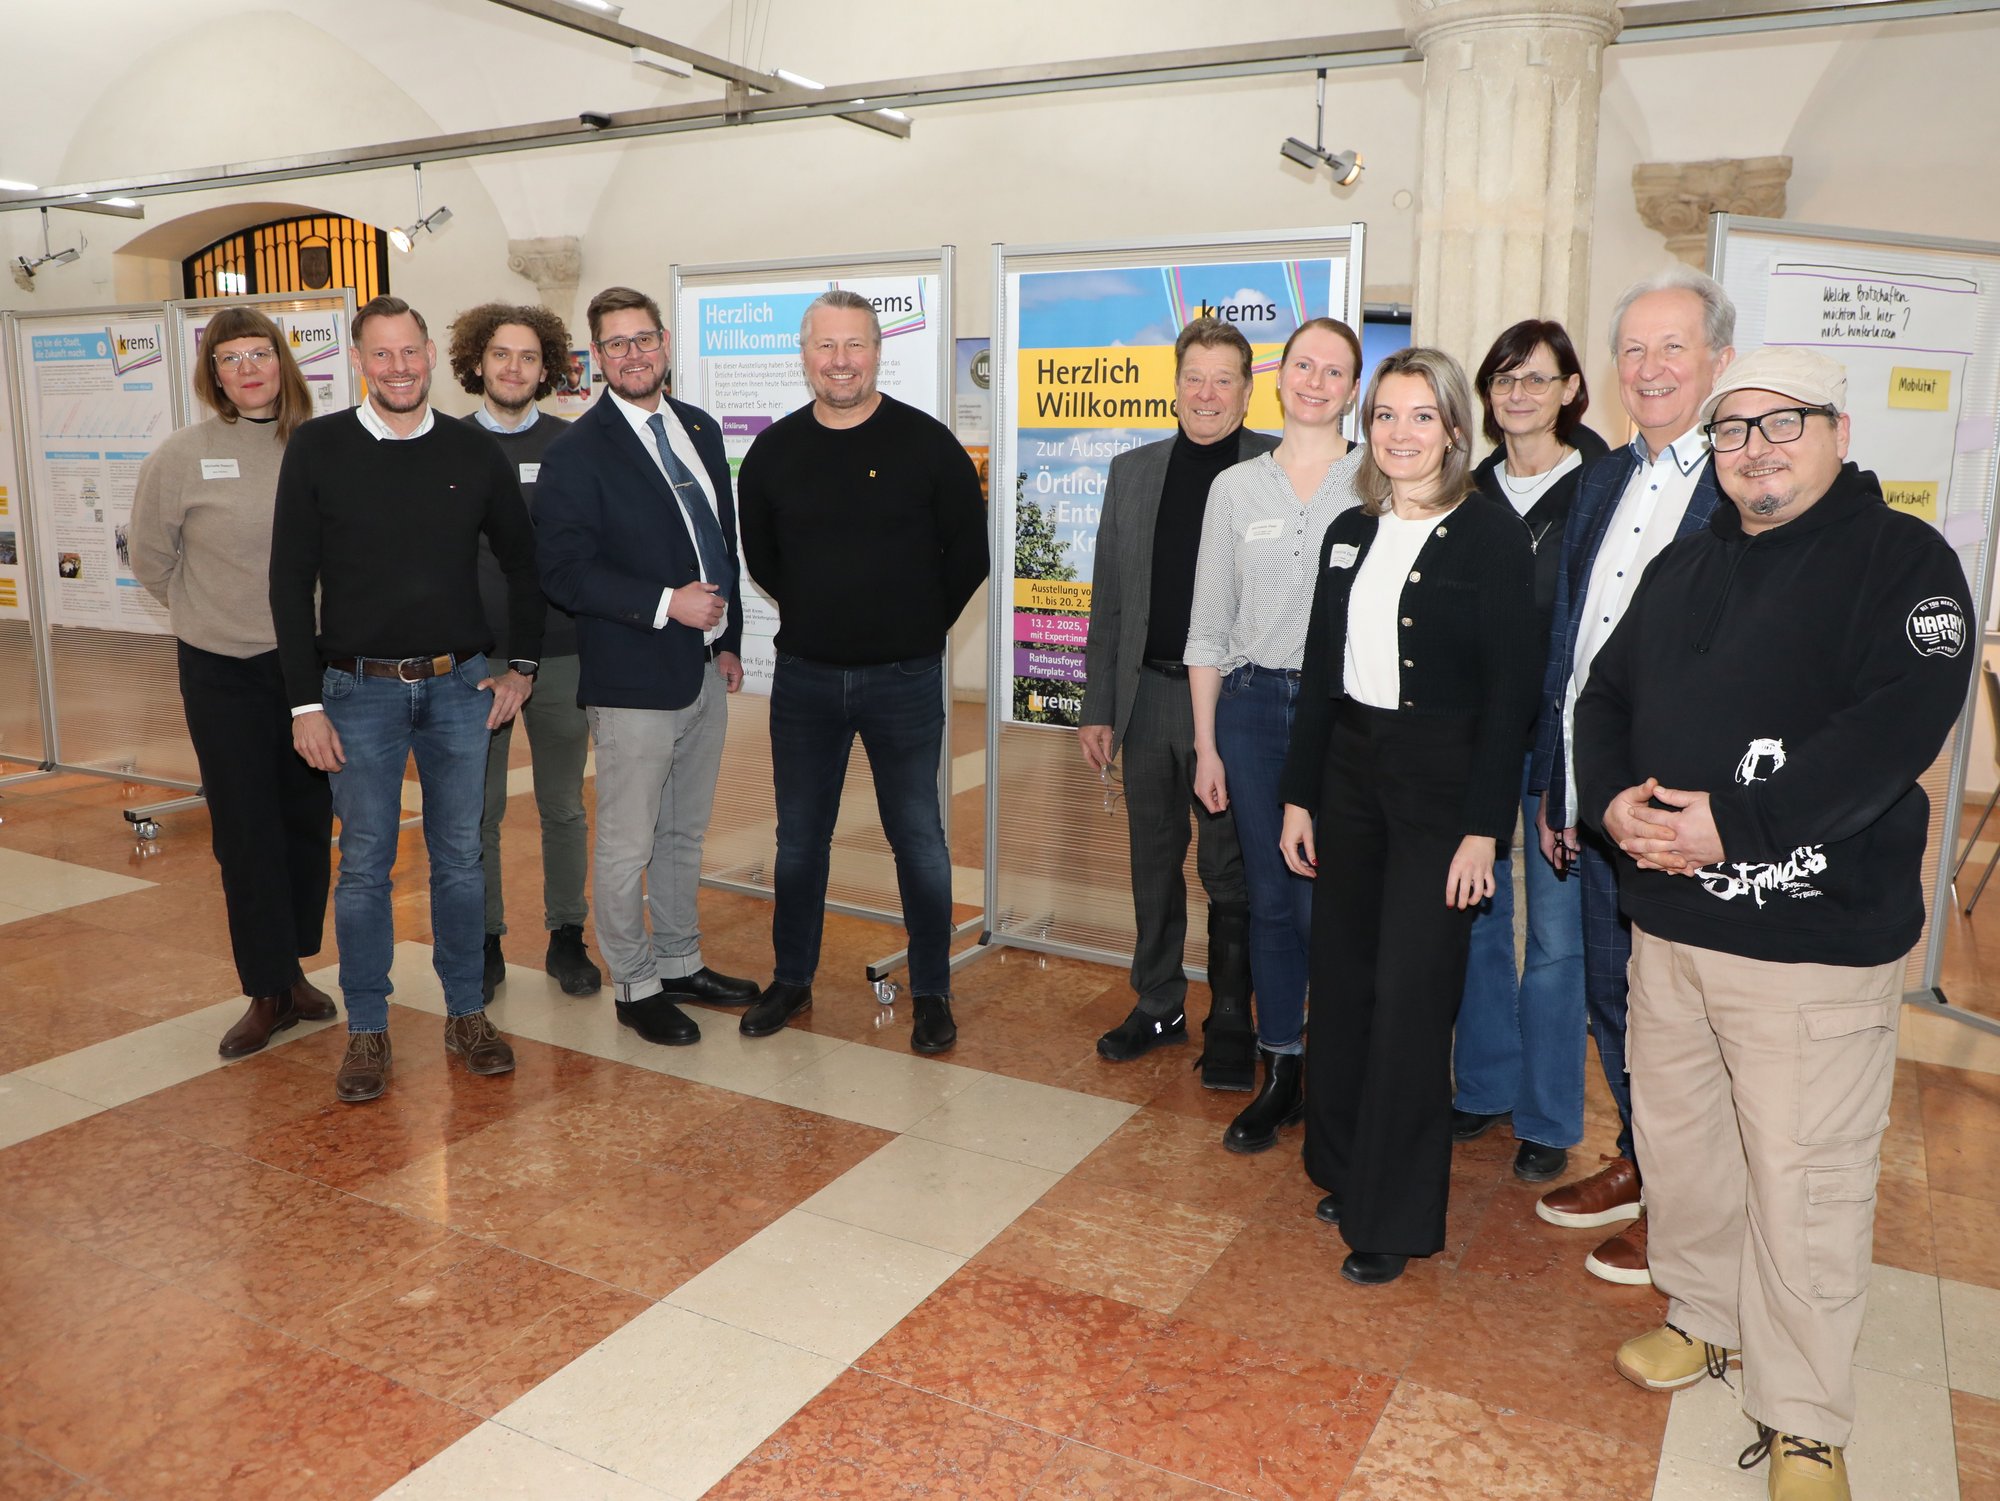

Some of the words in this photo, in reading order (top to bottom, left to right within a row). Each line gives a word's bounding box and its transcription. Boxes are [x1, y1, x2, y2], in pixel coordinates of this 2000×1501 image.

[706, 302, 773, 324] Herzlich
[1201, 299, 1276, 322] krems
[120, 334, 154, 350] krems
[293, 326, 332, 342] krems
[706, 330, 801, 350] Willkomme
[1038, 357, 1140, 385] Herzlich
[1036, 392, 1178, 418] Willkomme
[724, 422, 748, 431] Erklärung
[1036, 441, 1064, 457] zur
[1070, 437, 1149, 458] Ausstell
[1036, 465, 1108, 495] Örtlich
[1073, 530, 1096, 552] Kr
[1031, 583, 1078, 598] Ausstellung
[1032, 596, 1043, 605] 11.
[1046, 596, 1057, 606] bis
[1060, 598, 1074, 606] 20.
[1076, 598, 1084, 608] 2.
[1031, 618, 1044, 628] 13.
[1046, 620, 1054, 629] 2.
[1057, 620, 1082, 632] 2025,
[1912, 614, 1962, 634] HARRY
[1030, 631, 1043, 640] mit
[1044, 632, 1088, 642] Expert:inne
[755, 656, 764, 666] für
[766, 658, 774, 666] Ihr
[1029, 652, 1082, 668] Rathausfoyer
[744, 668, 762, 678] ukunft
[1029, 665, 1065, 677] Pfarrplatz
[1033, 690, 1082, 712] krems
